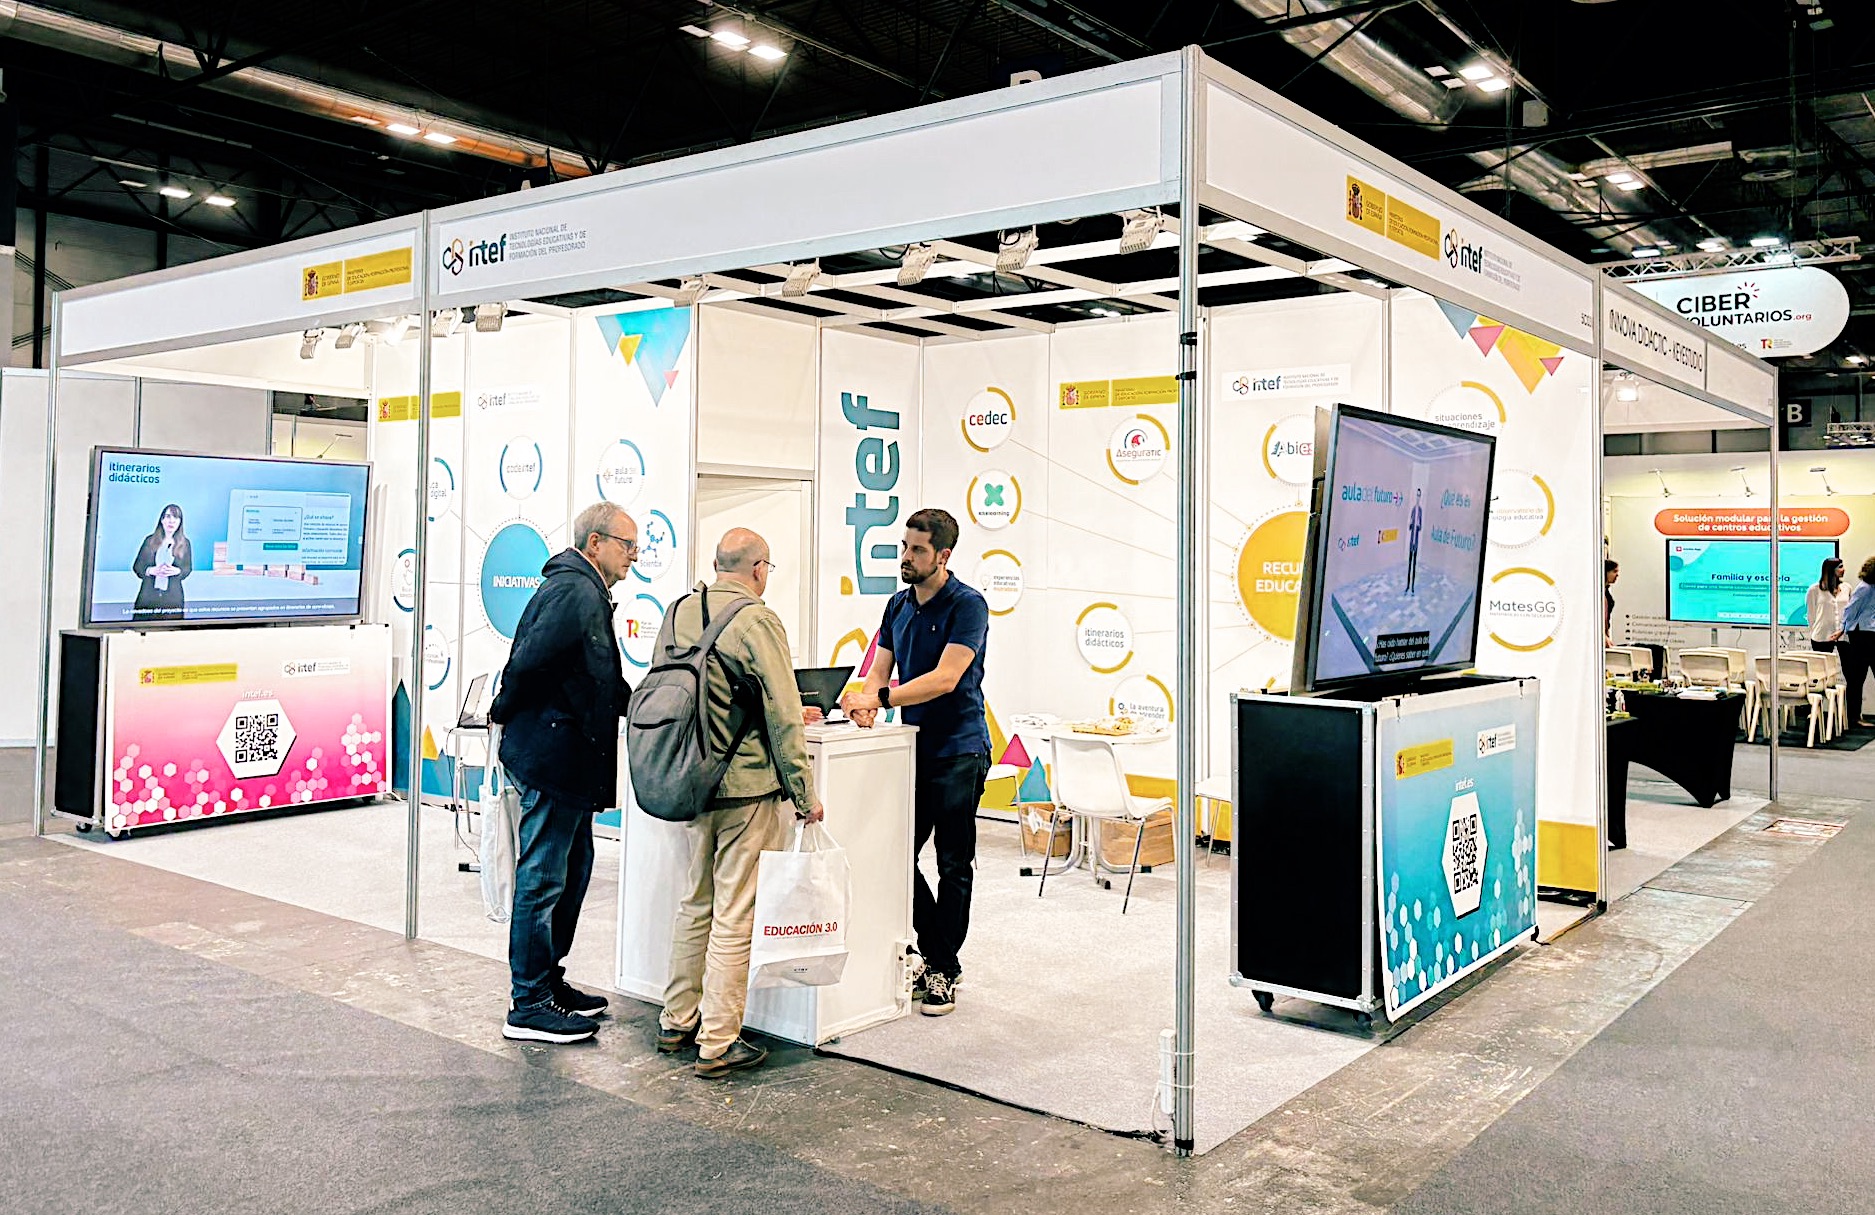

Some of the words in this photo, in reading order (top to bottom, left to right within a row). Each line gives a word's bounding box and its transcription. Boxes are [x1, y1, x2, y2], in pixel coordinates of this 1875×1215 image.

[509, 230, 535, 241] INSTITUTO
[535, 226, 559, 237] NACIONAL
[560, 223, 568, 232] DE
[469, 233, 507, 267] intef
[548, 241, 586, 254] PROFESORADO
[1461, 238, 1483, 274] intef
[1677, 293, 1750, 314] CIBER
[1686, 309, 1812, 327] OLUNTARIOS.org
[1609, 309, 1637, 342] INNOVA
[1638, 323, 1668, 355] DIDACTIC
[1253, 375, 1281, 391] intef
[969, 410, 1008, 426] cedec
[1435, 413, 1483, 422] situaciones
[1787, 404, 1803, 423] B
[109, 462, 161, 473] itinerarios
[109, 472, 160, 484] didácticos
[841, 392, 900, 595] intef
[1342, 482, 1361, 501] aula
[1673, 514, 1714, 523] Solución
[1716, 514, 1755, 523] modular
[1781, 514, 1790, 523] la
[1791, 513, 1828, 524] gestión
[1698, 524, 1710, 532] de
[1712, 524, 1747, 532] centros
[1749, 523, 1802, 532] eductivos
[1263, 561, 1304, 575] RECU
[493, 575, 540, 589] INICIATIVAS
[1711, 573, 1745, 581] Familia
[1746, 575, 1752, 583] y
[1490, 600, 1556, 613] MatesGG
[1085, 628, 1124, 639] itinerarios
[1085, 638, 1124, 648] didácticos
[298, 662, 316, 673] intef
[1138, 704, 1164, 712] aventura
[764, 922, 823, 936] EDUCACIÓN
[825, 921, 838, 933] 3.0
